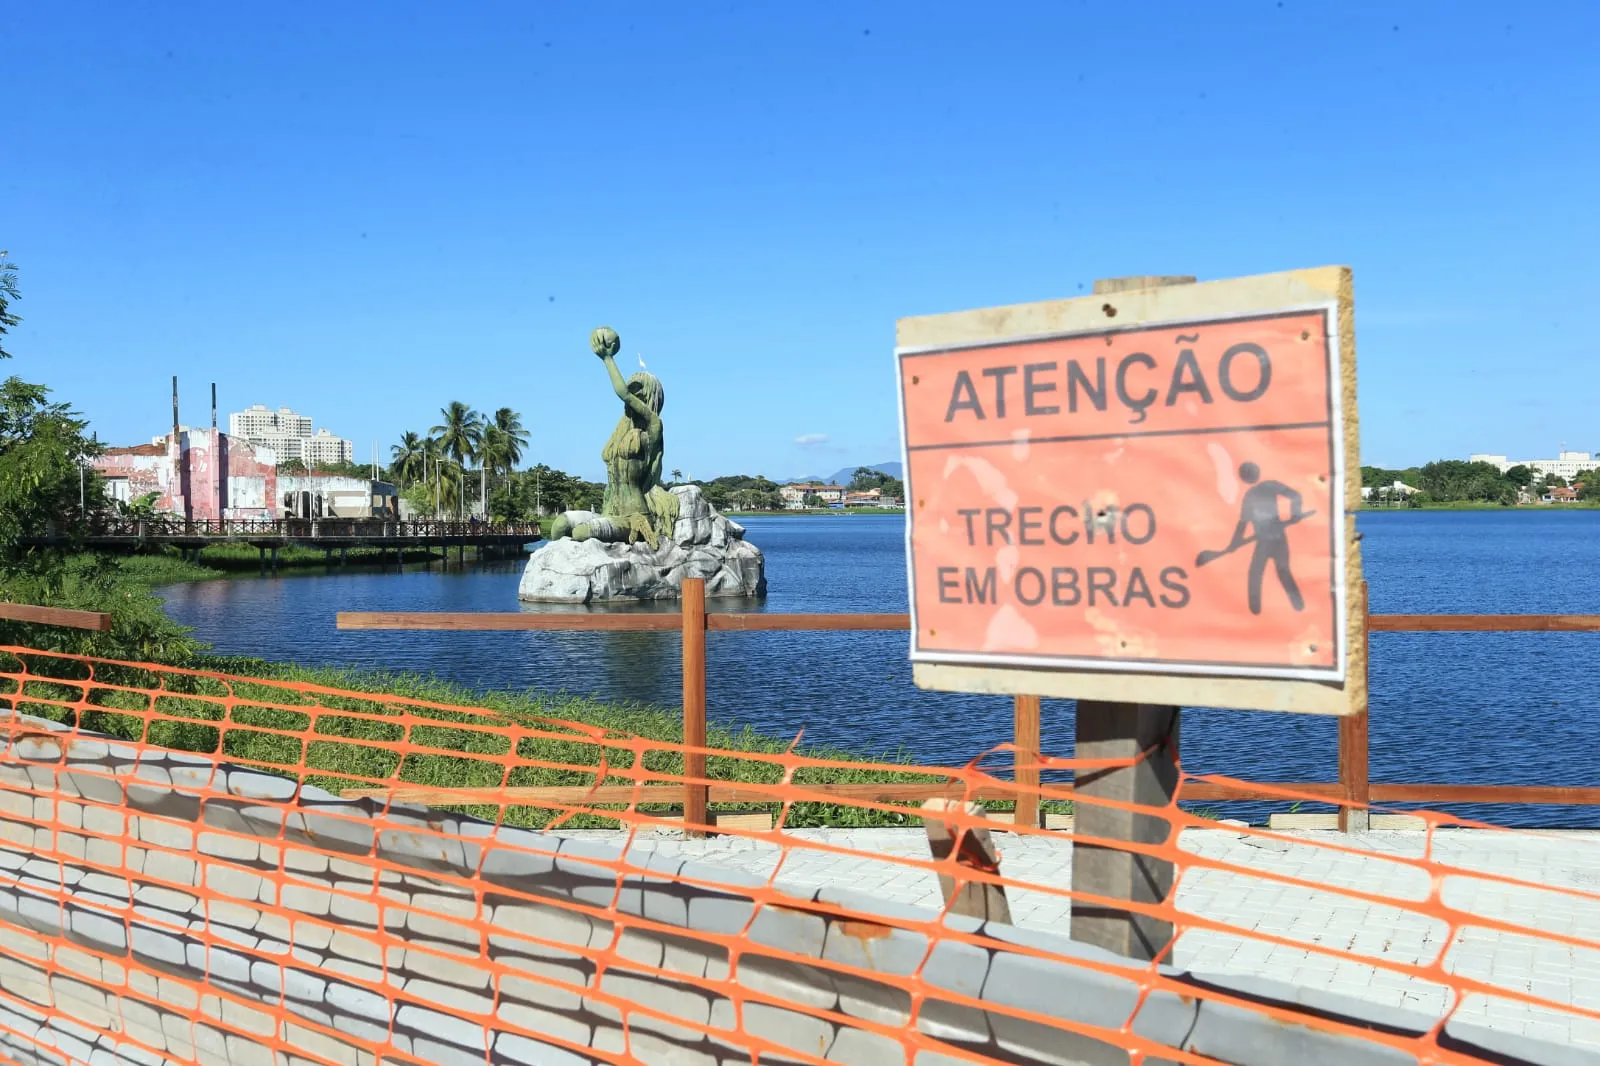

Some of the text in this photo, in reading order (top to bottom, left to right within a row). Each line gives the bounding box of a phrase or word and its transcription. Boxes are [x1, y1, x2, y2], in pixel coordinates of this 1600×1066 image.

[944, 333, 1272, 424] ATENÇÃO
[957, 503, 1156, 546] TRECHO
[938, 567, 1191, 609] EM OBRAS
